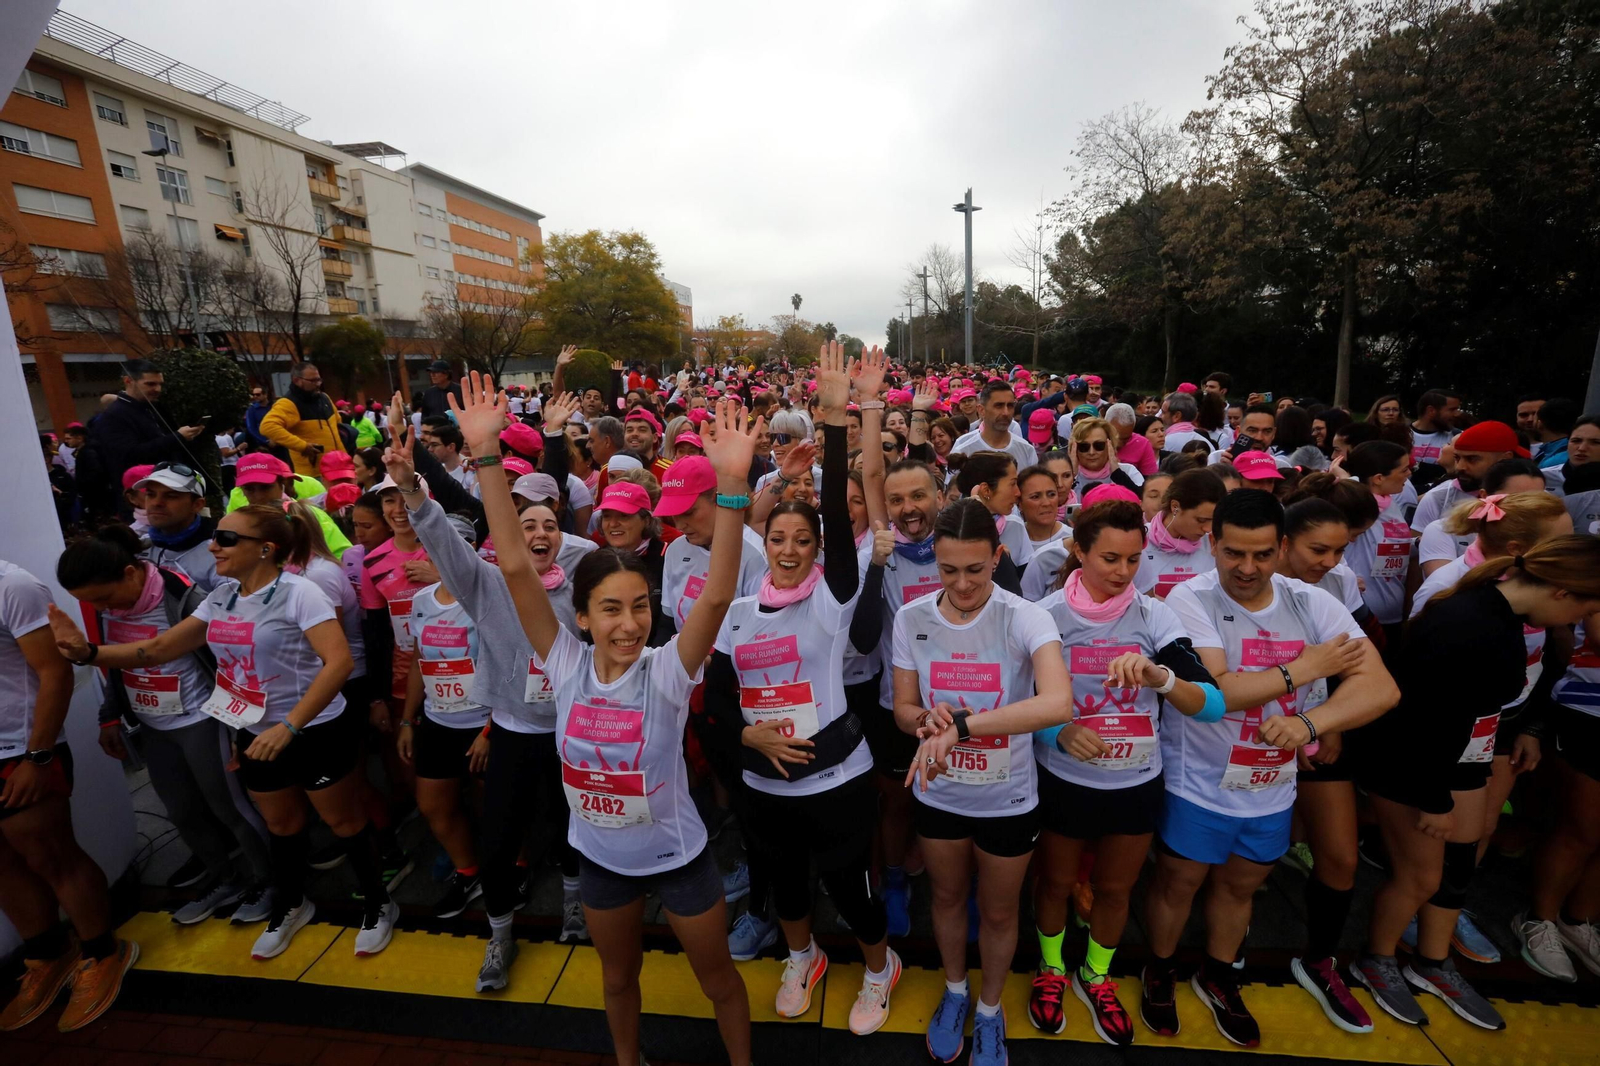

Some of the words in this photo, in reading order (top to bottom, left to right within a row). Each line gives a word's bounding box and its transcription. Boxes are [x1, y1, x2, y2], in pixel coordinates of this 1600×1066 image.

[240, 463, 268, 472] sinvello!
[605, 490, 632, 498] sinvello!
[1384, 558, 1402, 568] 2049
[740, 652, 758, 660] PINK
[758, 645, 790, 658] RUNNING
[937, 672, 955, 680] PINK
[956, 672, 992, 681] RUNNING
[435, 682, 464, 698] 976
[762, 689, 776, 698] 100
[135, 692, 159, 707] 466
[226, 696, 248, 716] 767
[576, 716, 593, 728] PINK
[595, 720, 633, 730] RUNNING
[584, 728, 608, 738] CADENA
[950, 750, 987, 771] 1755
[590, 772, 605, 781] 100
[1250, 770, 1280, 784] 547
[580, 793, 625, 816] 2482
